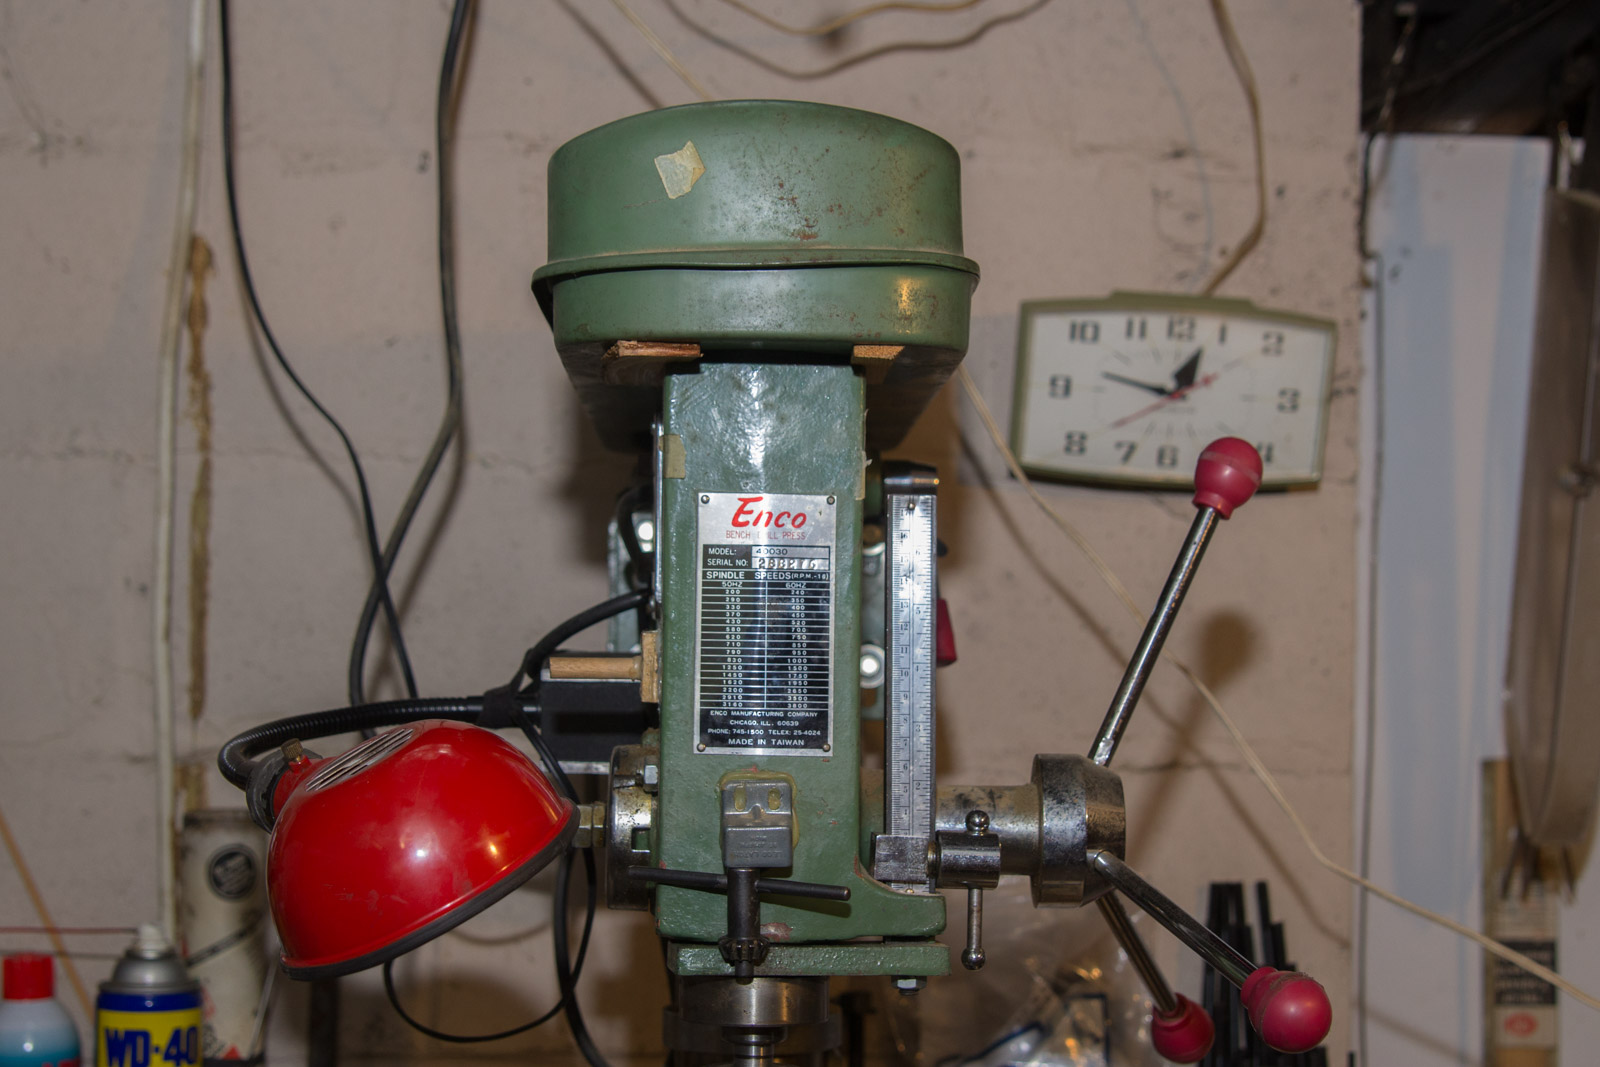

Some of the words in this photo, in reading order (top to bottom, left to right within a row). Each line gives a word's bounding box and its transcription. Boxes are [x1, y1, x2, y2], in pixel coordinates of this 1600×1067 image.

[1069, 320, 1099, 344] 10
[1125, 317, 1147, 340] 11
[1167, 317, 1195, 341] 12
[1219, 324, 1227, 345] 1
[1262, 331, 1284, 356] 2
[1049, 375, 1071, 398] 9
[1277, 388, 1299, 412] 3
[1065, 431, 1087, 455] 8
[1115, 440, 1137, 465] 7
[1157, 445, 1178, 467] 6
[731, 496, 807, 529] Enco
[726, 530, 751, 540] BENCH
[758, 530, 779, 540] DILL
[782, 531, 806, 541] PRESS
[708, 547, 737, 556] MODEL:
[707, 558, 734, 567] SERIAL
[736, 558, 749, 567] NO:
[706, 571, 745, 580] SPINDLE
[900, 623, 908, 631] 12
[731, 710, 784, 718] MANUFACTURING
[707, 728, 731, 736] PHONE:
[732, 728, 764, 736] 745-1500
[916, 724, 921, 732] 3
[728, 738, 753, 746] MADE
[772, 739, 805, 747] TAIWAN
[903, 762, 908, 770] 6
[916, 782, 921, 790] 2
[105, 1027, 198, 1067] WD-40
